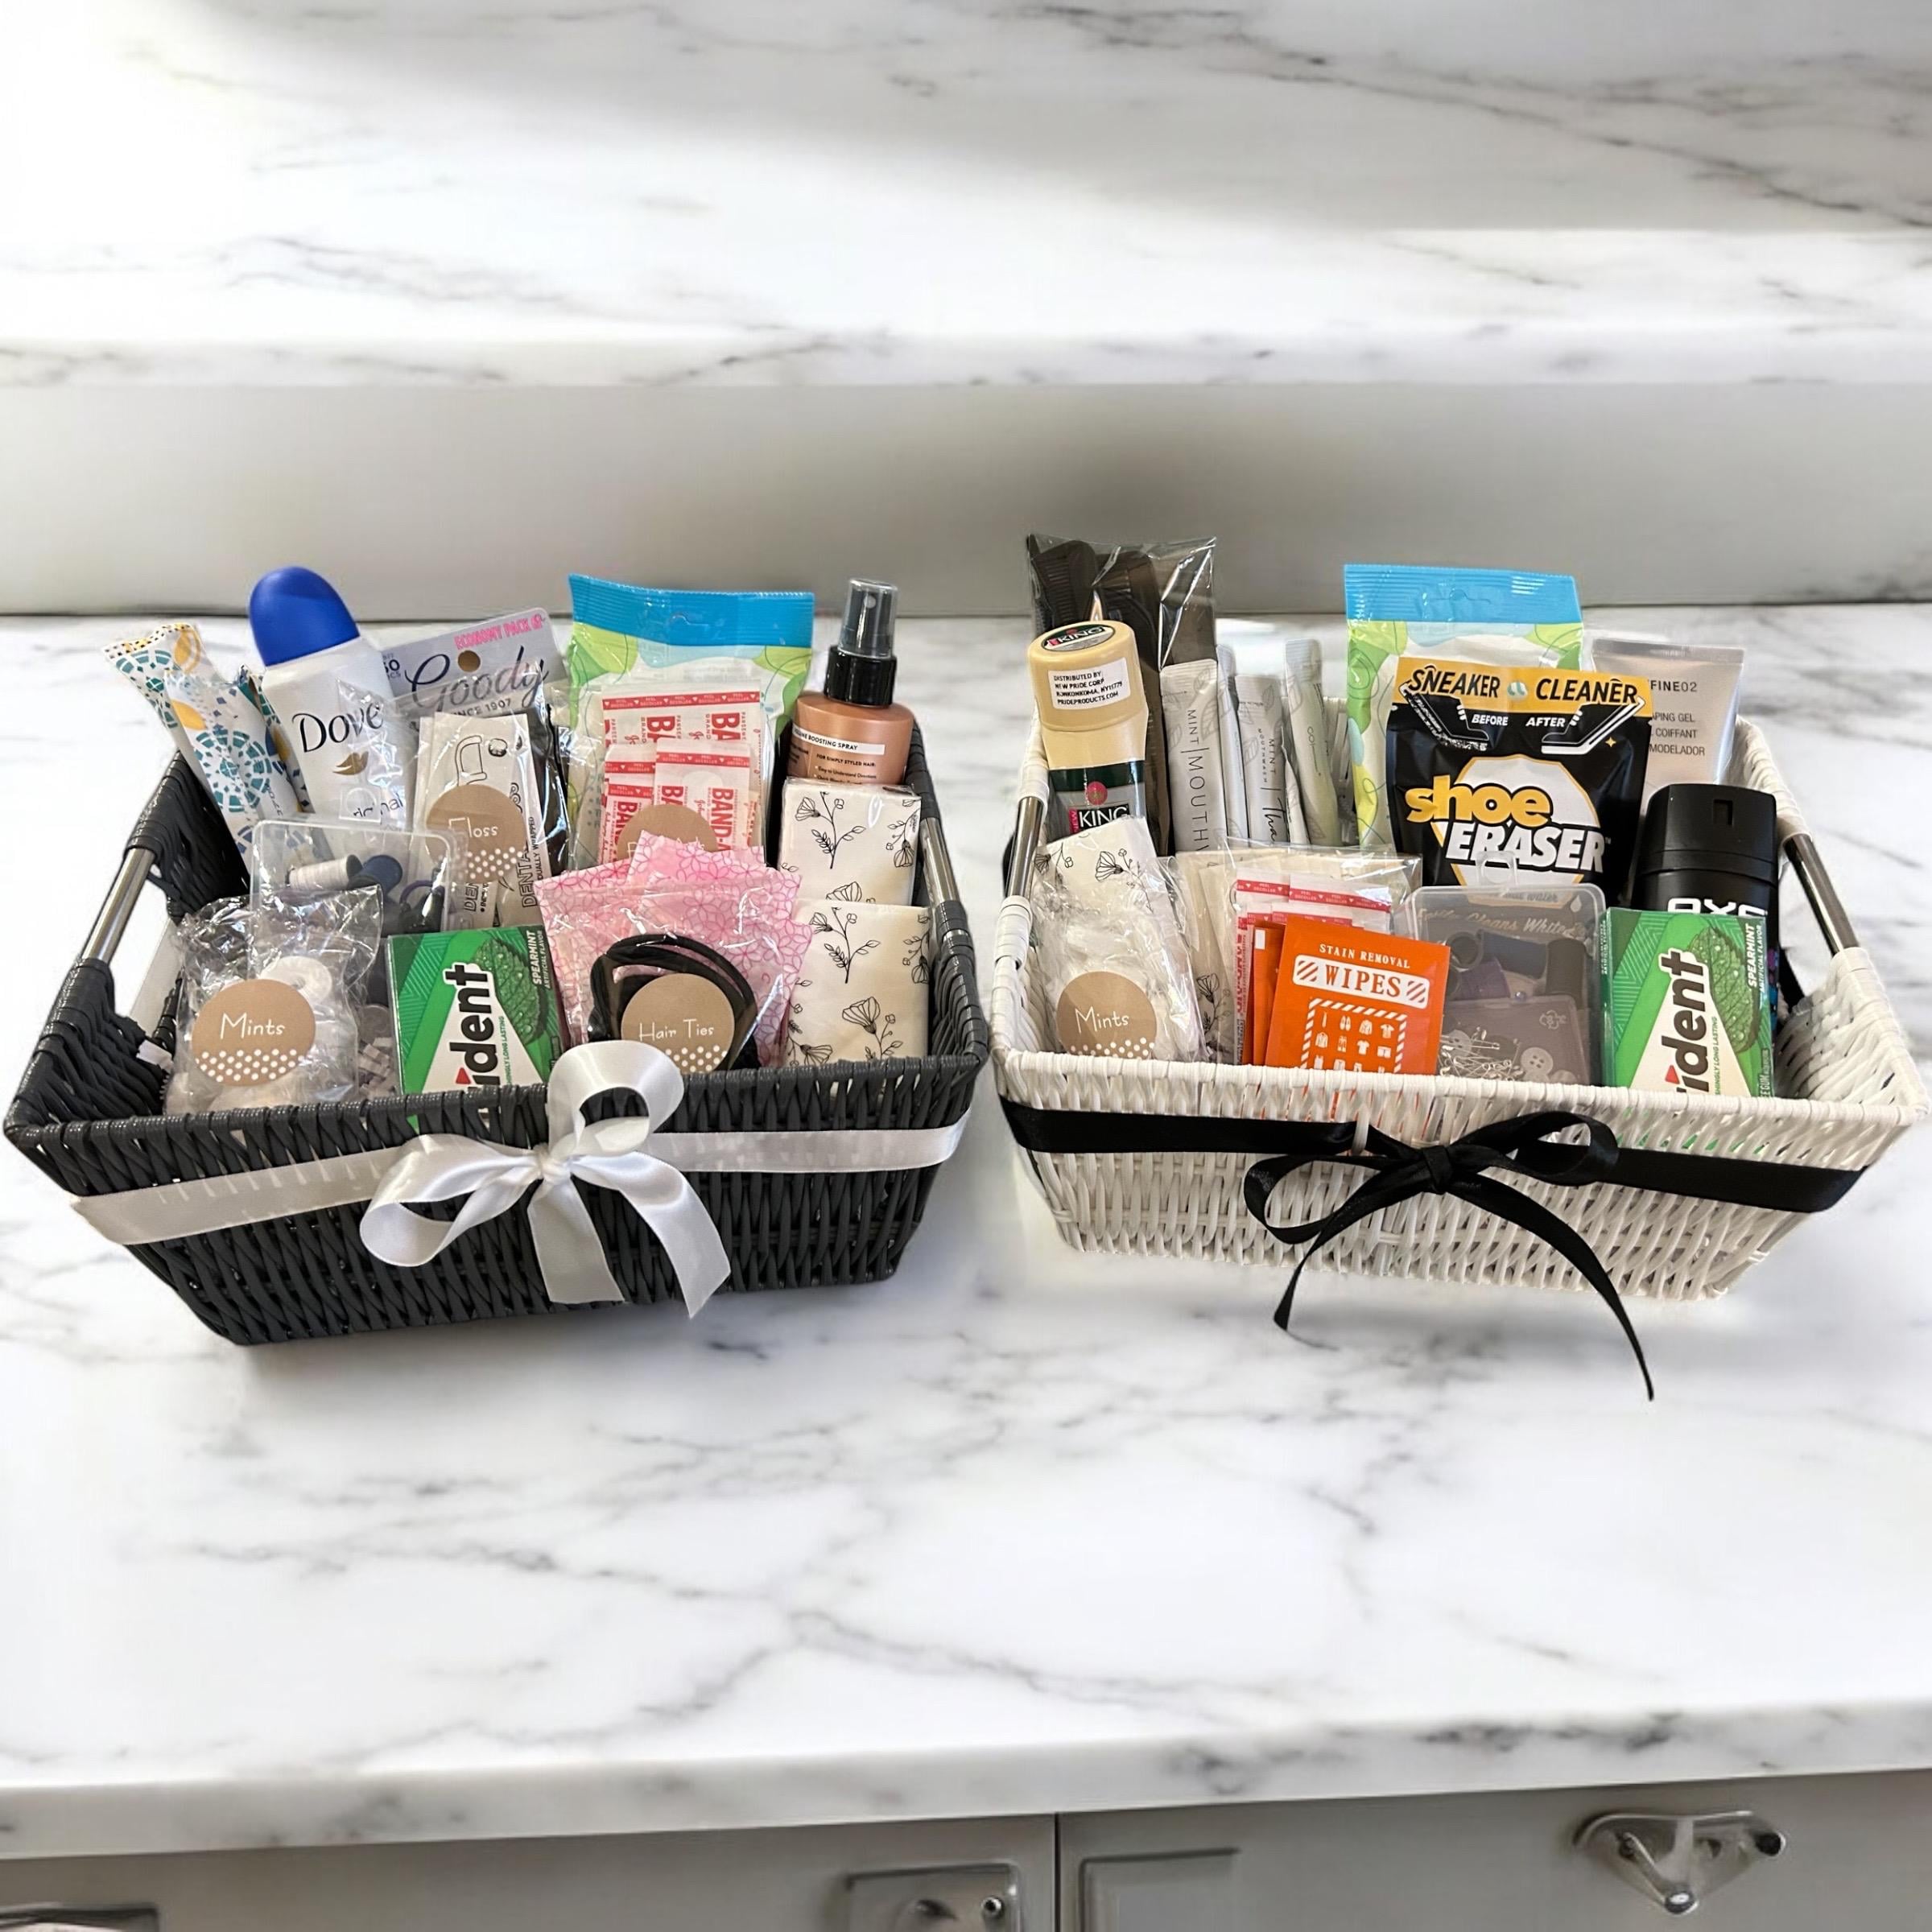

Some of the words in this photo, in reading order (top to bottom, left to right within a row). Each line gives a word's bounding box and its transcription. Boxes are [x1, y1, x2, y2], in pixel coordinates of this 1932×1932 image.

[405, 646, 549, 712] Goody
[1054, 673, 1092, 682] DISTRIBUTED
[1069, 680, 1088, 689] PRIDE
[1088, 678, 1105, 687] CORP
[1409, 667, 1501, 698] SNEAKER
[1535, 677, 1638, 704] CLEANER
[485, 698, 512, 712] 1907
[1677, 713, 1696, 723] GEL
[291, 703, 384, 753] Dove
[1187, 709, 1199, 745] MINT
[1471, 713, 1509, 727] BEFORE
[1525, 716, 1567, 728] AFTER
[1655, 728, 1699, 739] COIFFANT
[808, 734, 837, 747] BOOSTING
[837, 742, 858, 750] SPRAY
[1269, 738, 1277, 774] MINT
[1649, 743, 1706, 756] MODELADOR
[1405, 774, 1551, 828] shoe
[1445, 822, 1606, 873] ERASER
[526, 931, 543, 985] SPEARMINT
[1319, 943, 1356, 960] STAIN
[1360, 951, 1411, 969] REMOVAL
[1745, 923, 1757, 989] SPEARMINT
[1324, 964, 1402, 998] WIPES
[220, 1012, 286, 1040] Mints
[445, 964, 501, 1089] ident
[498, 1016, 508, 1042] LASTING
[638, 1022, 677, 1042] Hair
[683, 1018, 715, 1039] Ties
[1075, 1005, 1130, 1034] Mints
[1661, 951, 1710, 1093] ident
[502, 1042, 510, 1059] LONG
